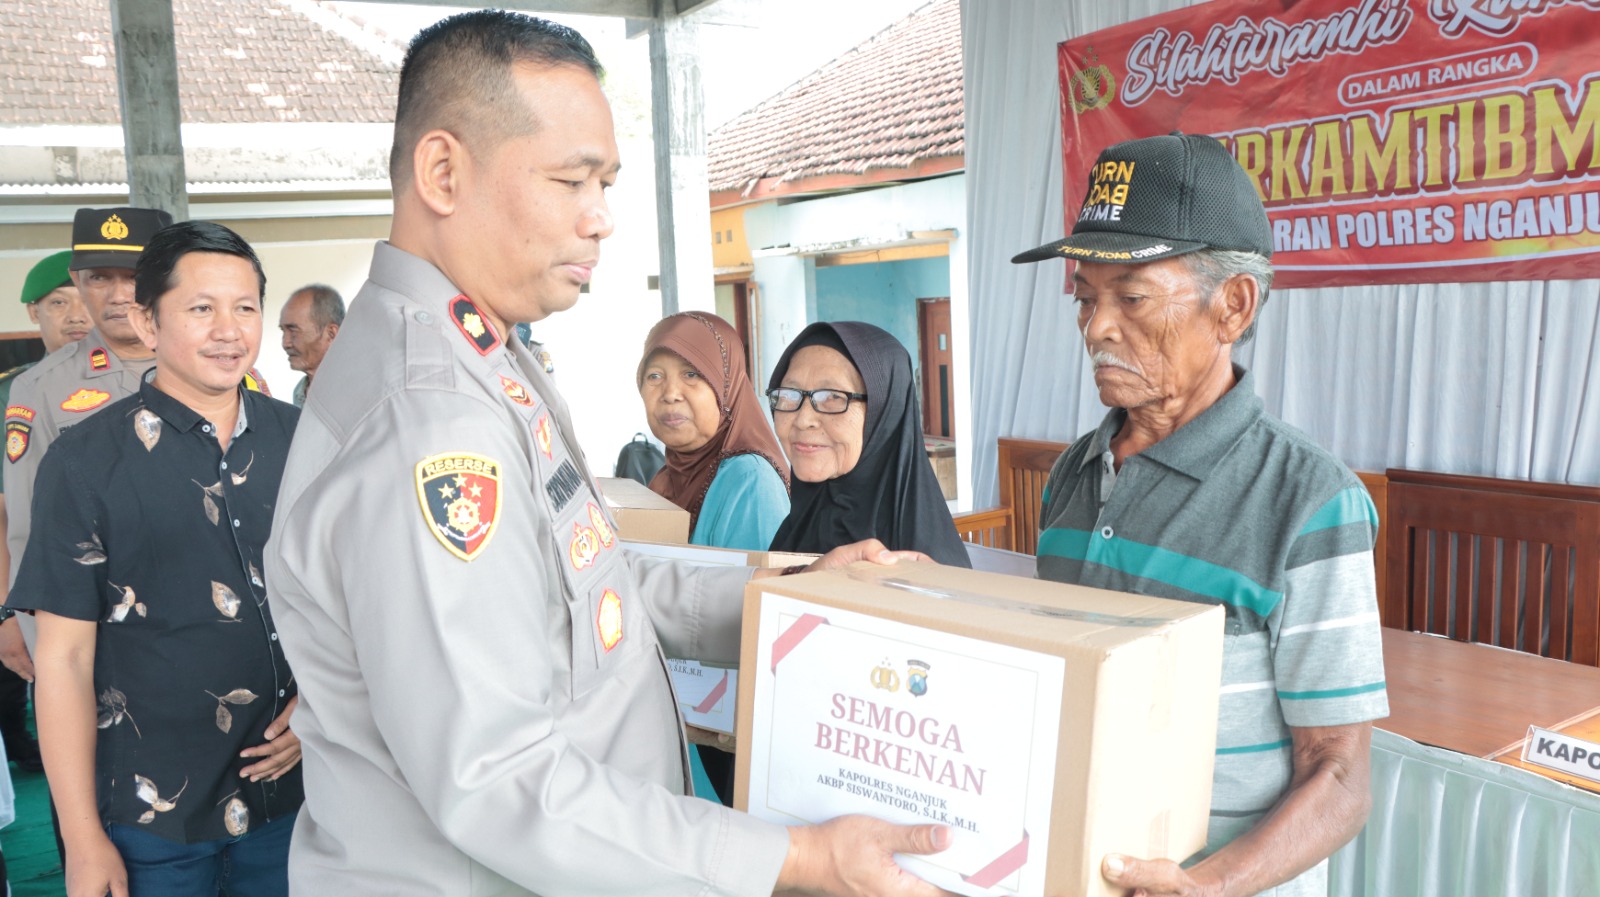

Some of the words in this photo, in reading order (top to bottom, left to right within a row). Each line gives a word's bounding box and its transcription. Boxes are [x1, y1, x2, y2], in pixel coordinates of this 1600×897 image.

[1347, 71, 1420, 100] DALAM
[1427, 52, 1524, 85] RANGKA
[1220, 80, 1600, 202] RKAMTIBM
[1057, 245, 1092, 257] TURN
[1131, 243, 1174, 258] CRIME
[1273, 215, 1331, 251] RAN
[1336, 205, 1455, 249] POLRES
[424, 457, 493, 476] RESERSE
[830, 692, 964, 754] SEMOGA
[814, 722, 987, 797] BERKENAN
[816, 773, 845, 790] AKBP
[846, 782, 921, 816] SISWANTORO,
[838, 767, 893, 793] KAPOLRES
[895, 785, 948, 810] NGANJUK
